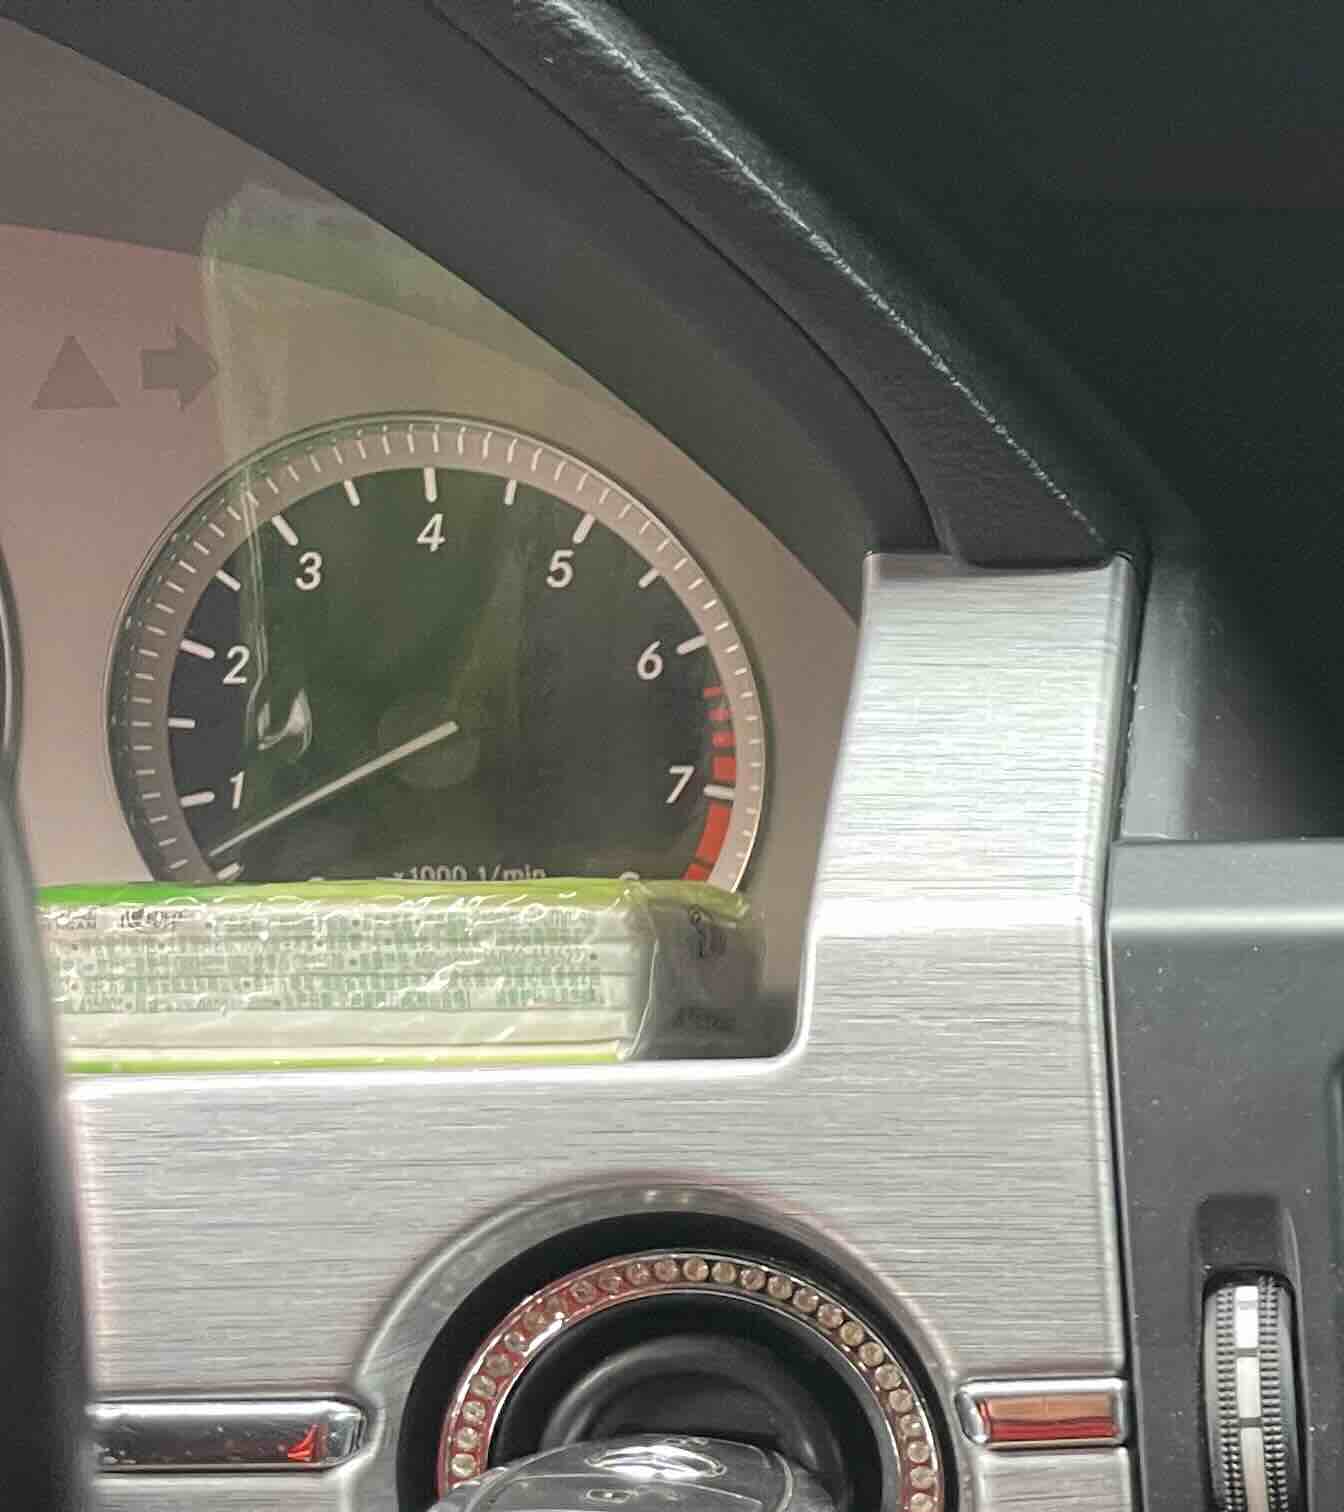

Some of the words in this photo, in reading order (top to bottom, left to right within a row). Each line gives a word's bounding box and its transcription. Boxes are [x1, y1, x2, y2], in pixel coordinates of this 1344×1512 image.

[416, 513, 446, 553] 4
[295, 553, 323, 591] 3
[545, 550, 574, 589] 5
[222, 646, 249, 685] 2
[635, 643, 665, 681] 6
[228, 773, 246, 809] 1
[666, 766, 696, 804] 7
